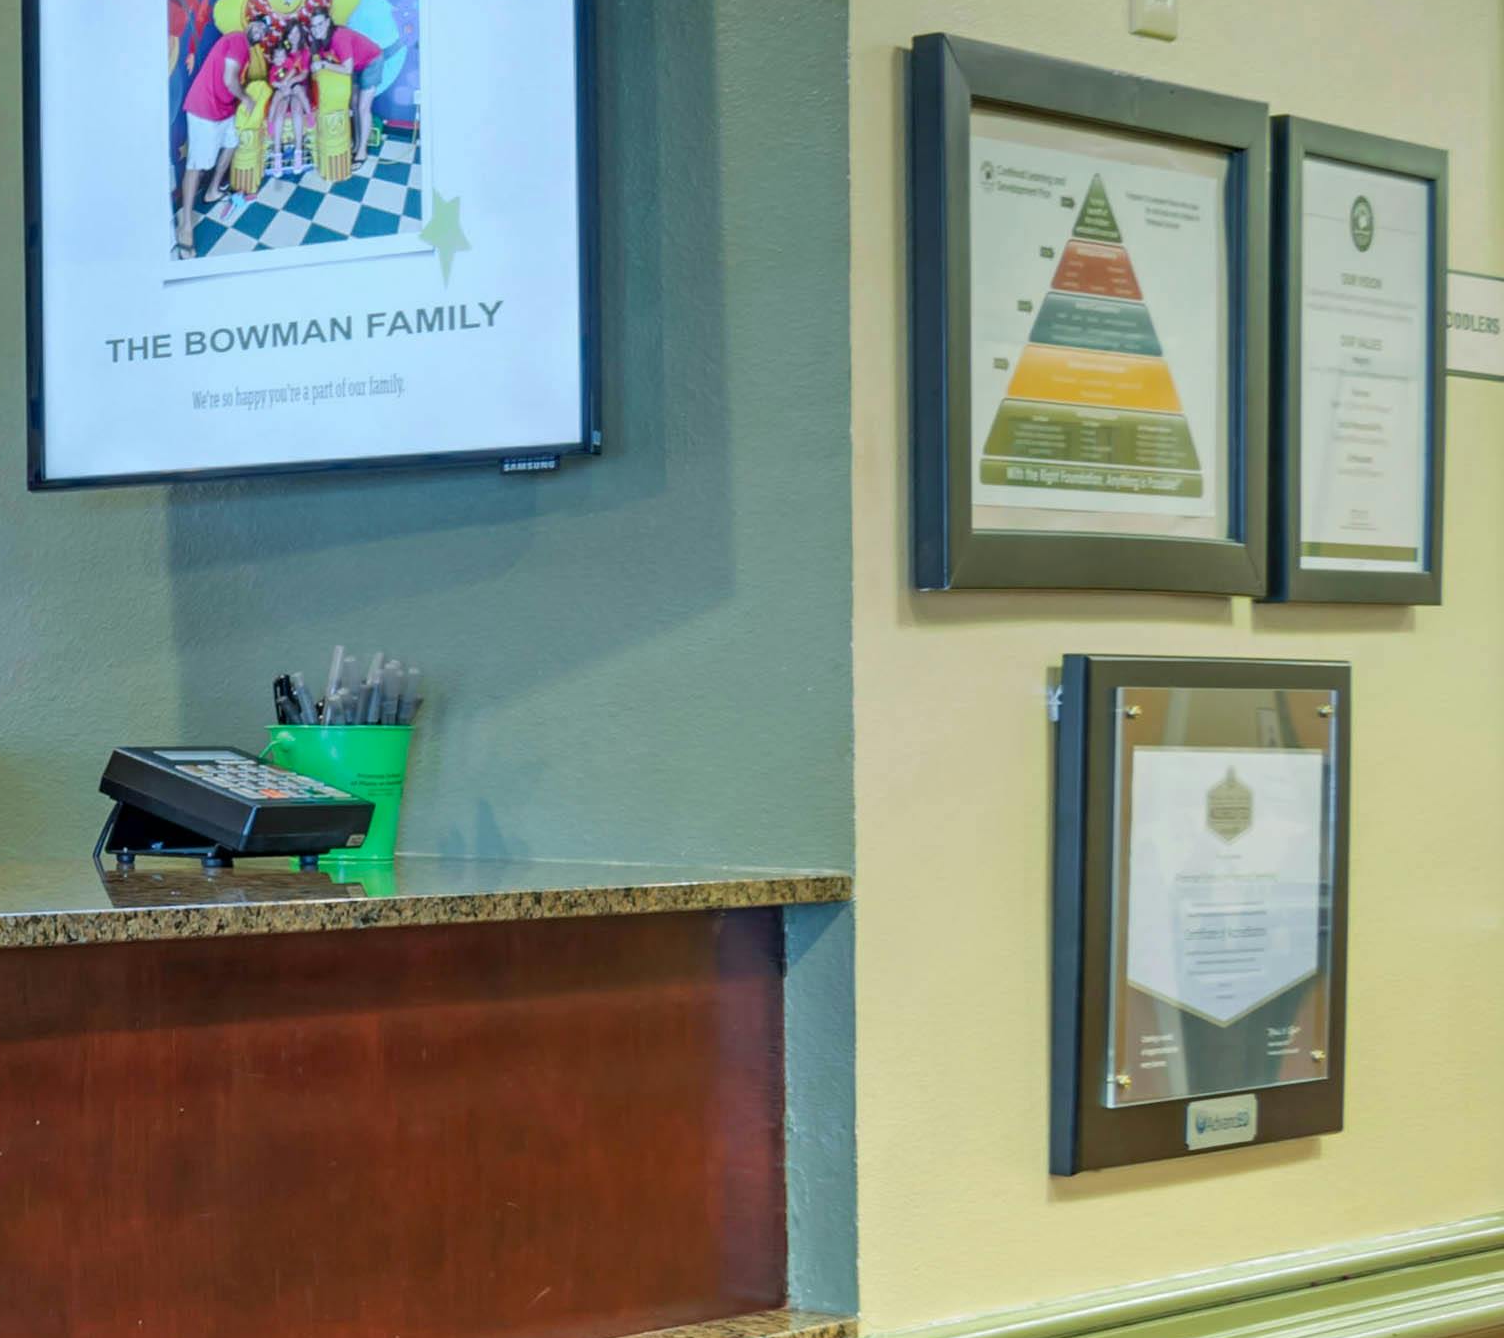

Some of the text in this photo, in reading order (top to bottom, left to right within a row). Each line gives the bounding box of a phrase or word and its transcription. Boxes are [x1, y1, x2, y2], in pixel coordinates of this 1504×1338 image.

[106, 299, 504, 363] THE BOWMAN FAMILY
[1446, 310, 1500, 334] ODDLERS
[504, 461, 555, 472] SAMSUNG
